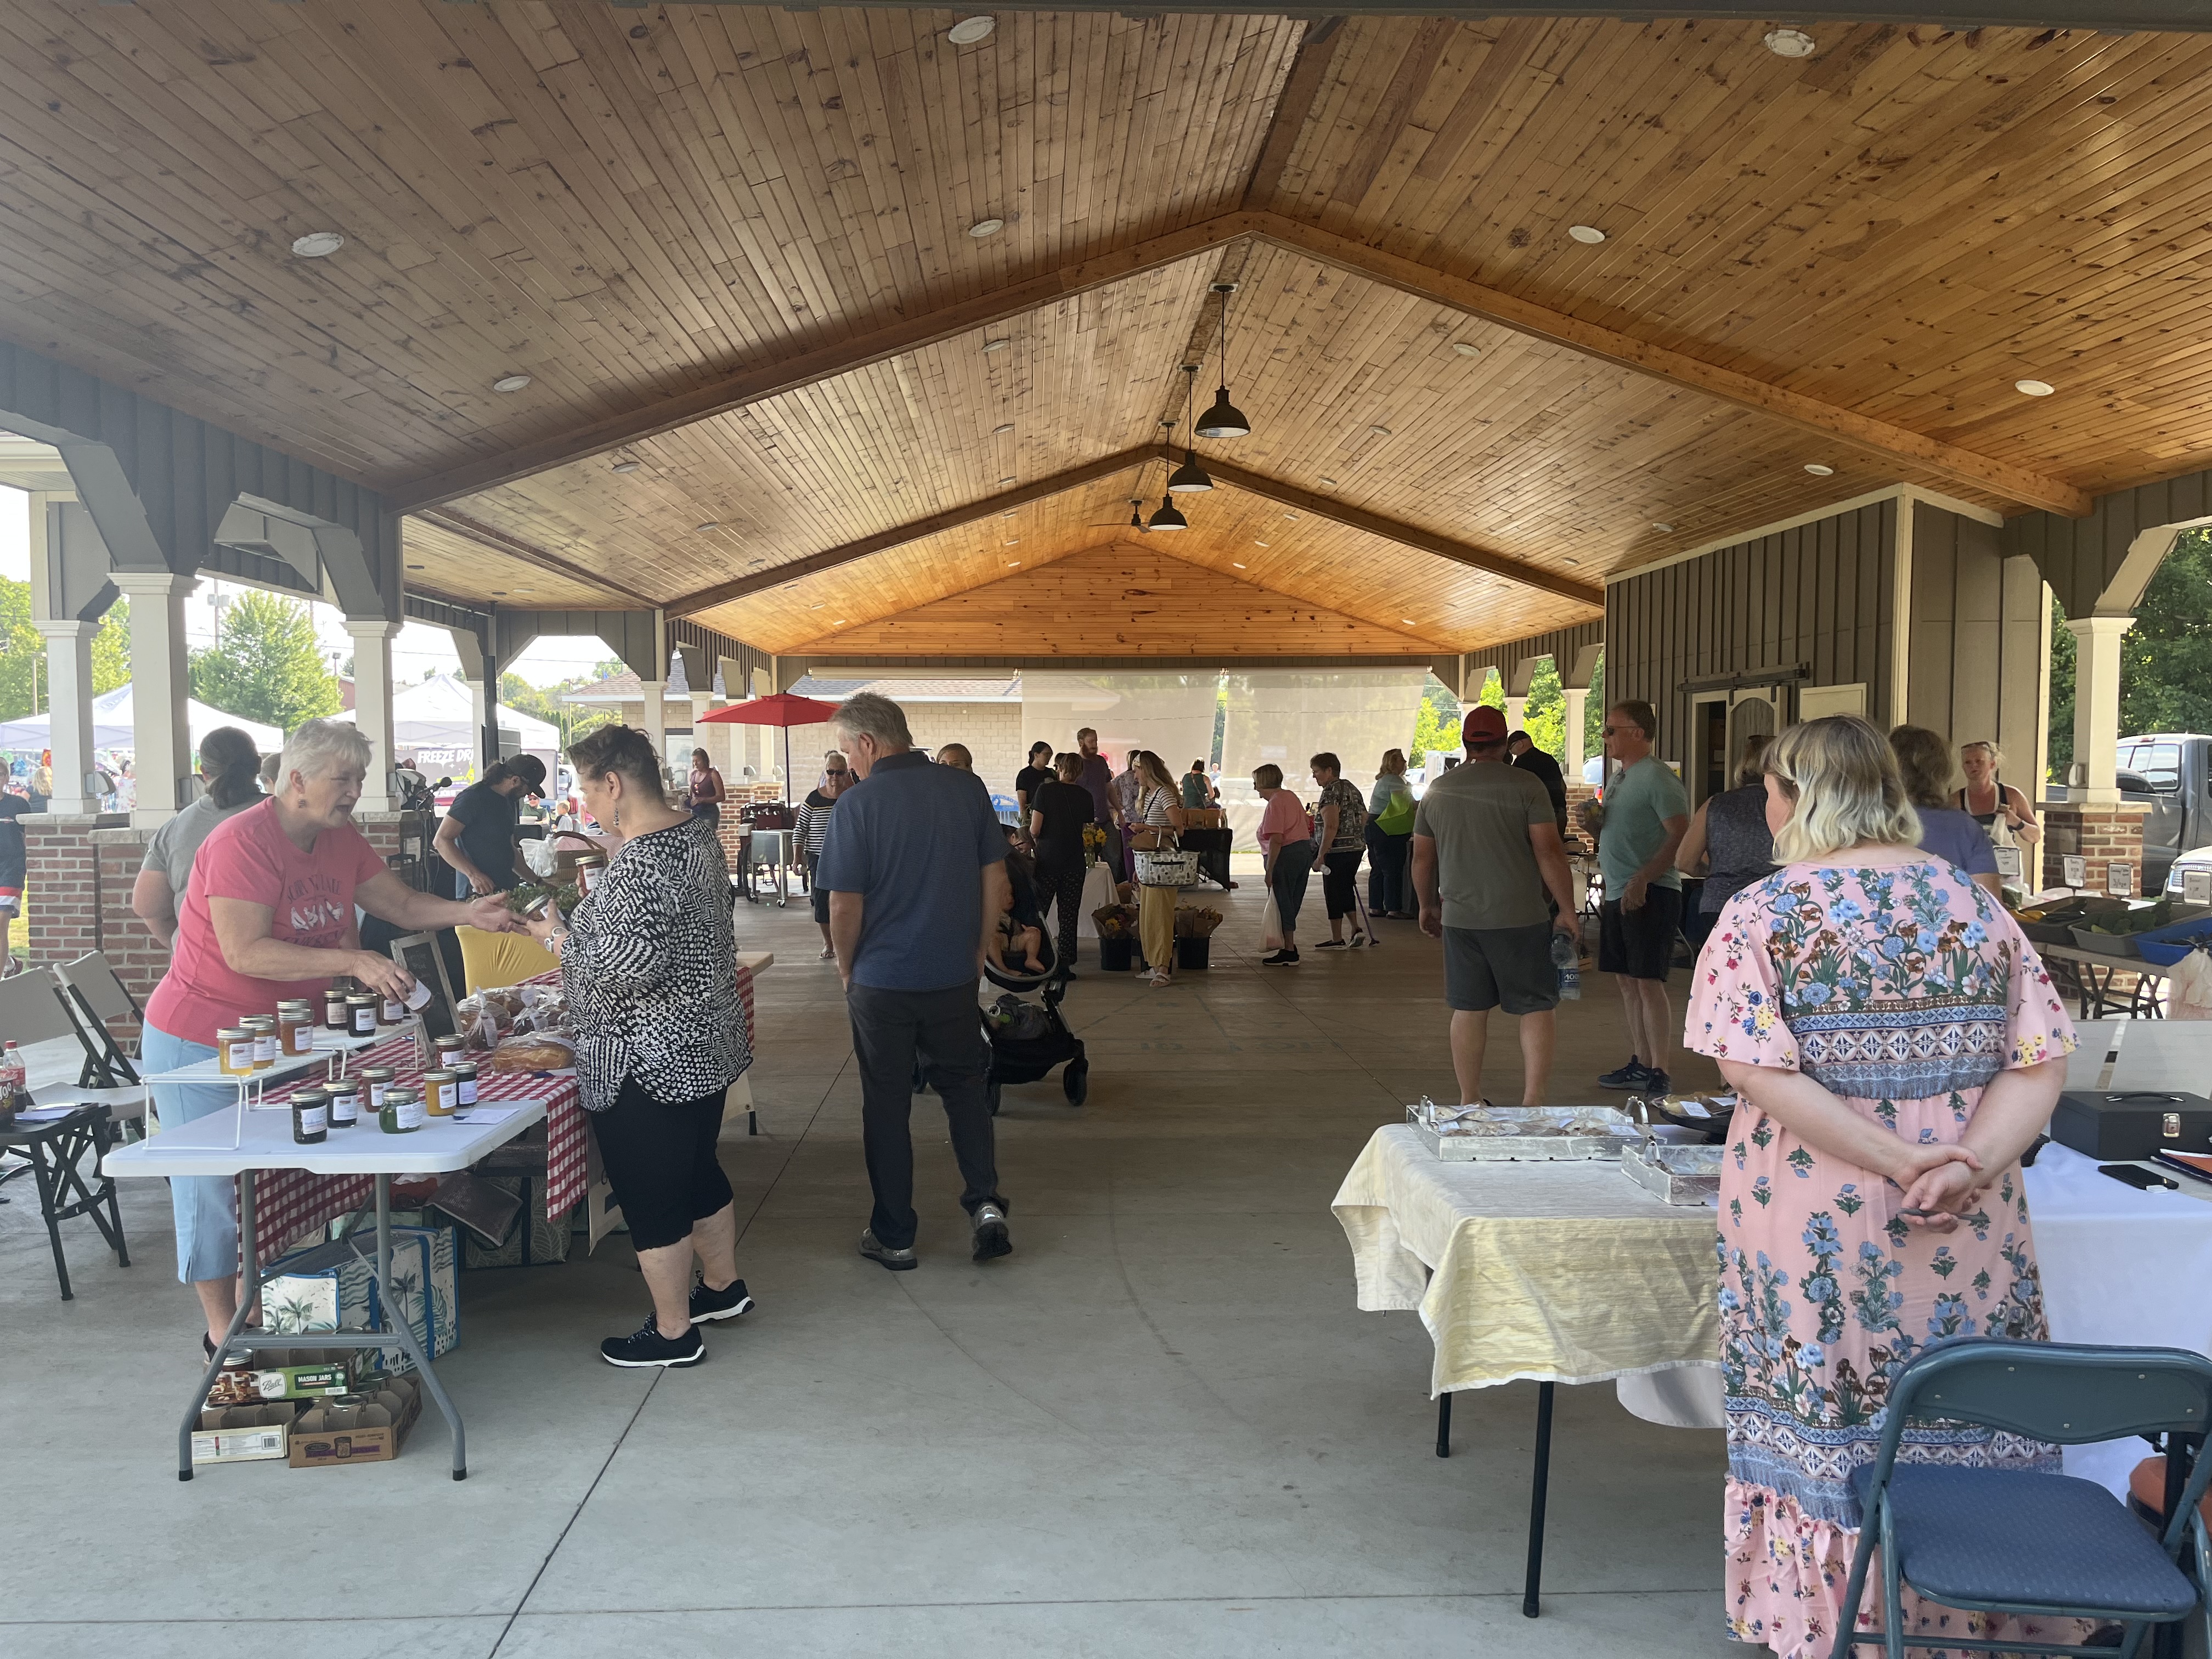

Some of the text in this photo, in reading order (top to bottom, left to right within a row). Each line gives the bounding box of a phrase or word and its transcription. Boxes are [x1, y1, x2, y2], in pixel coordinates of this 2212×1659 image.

[417, 749, 455, 764] FREEZE
[262, 1378, 283, 1392] Ball
[298, 1373, 332, 1383] MASON JARS
